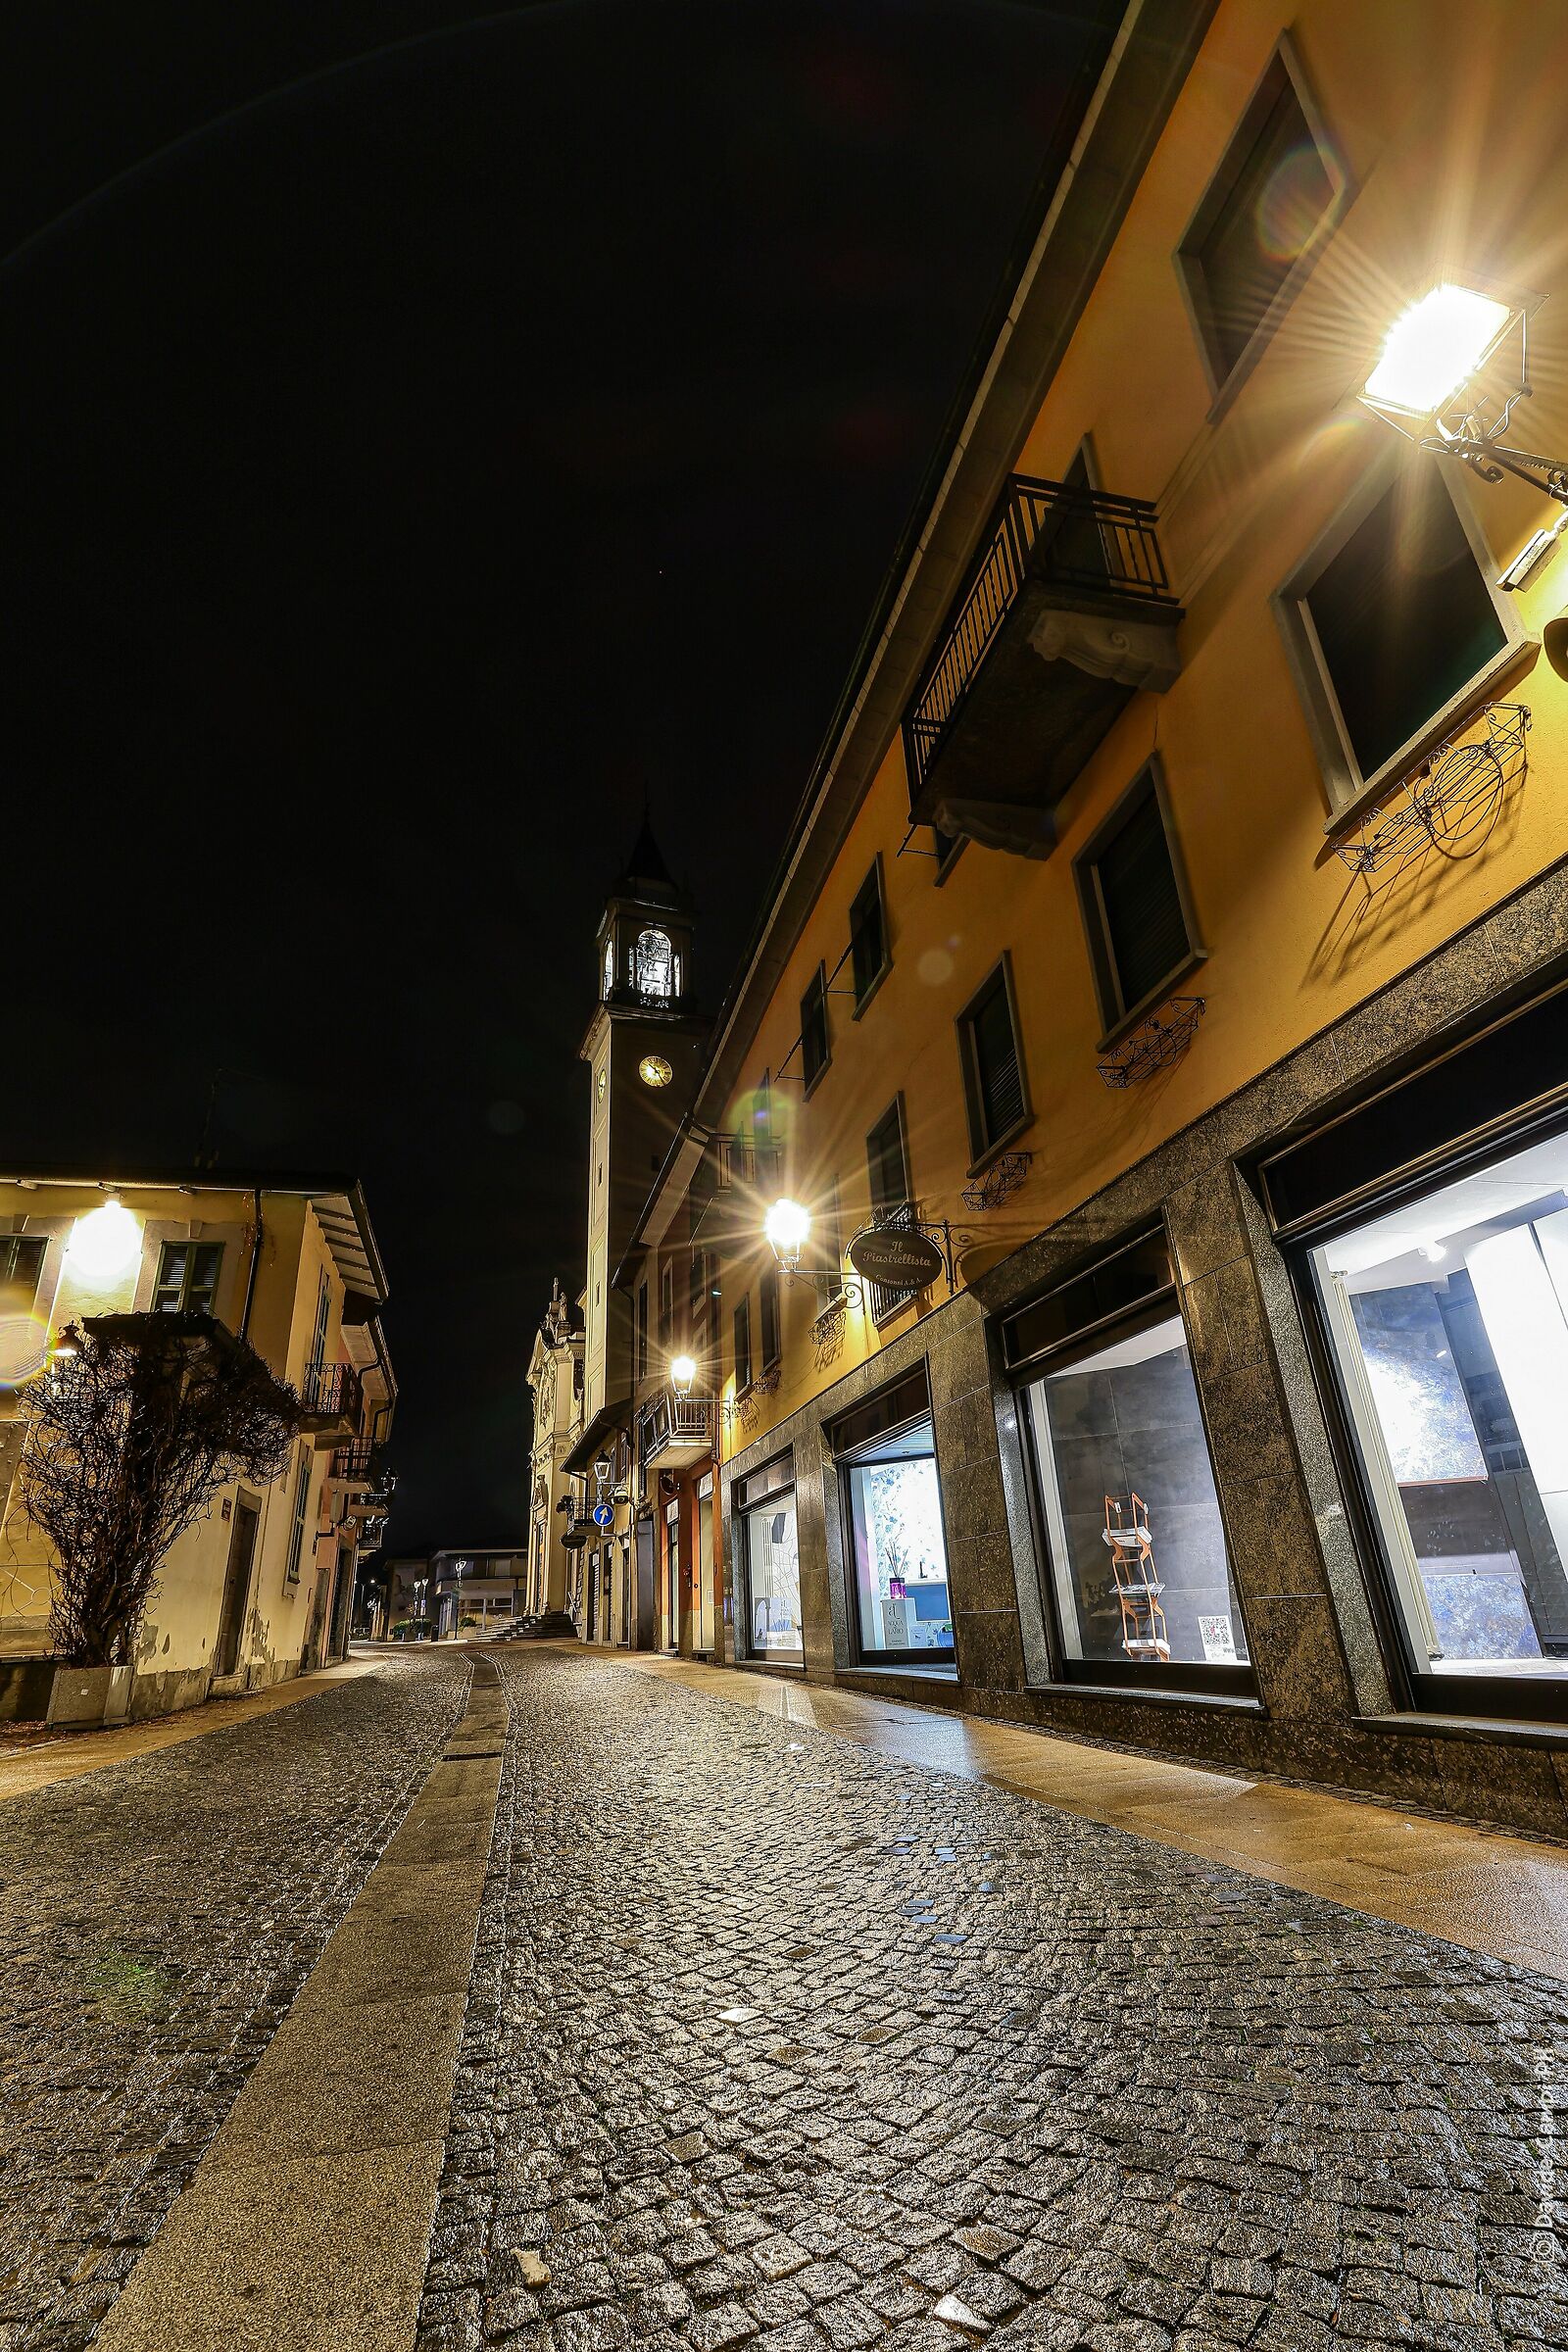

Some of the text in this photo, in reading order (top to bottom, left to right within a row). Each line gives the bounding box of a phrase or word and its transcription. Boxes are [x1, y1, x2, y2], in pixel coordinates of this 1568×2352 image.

[890, 1241, 904, 1252] Il
[862, 1251, 932, 1266] Piastrellista
[875, 1274, 904, 1286] Consonni
